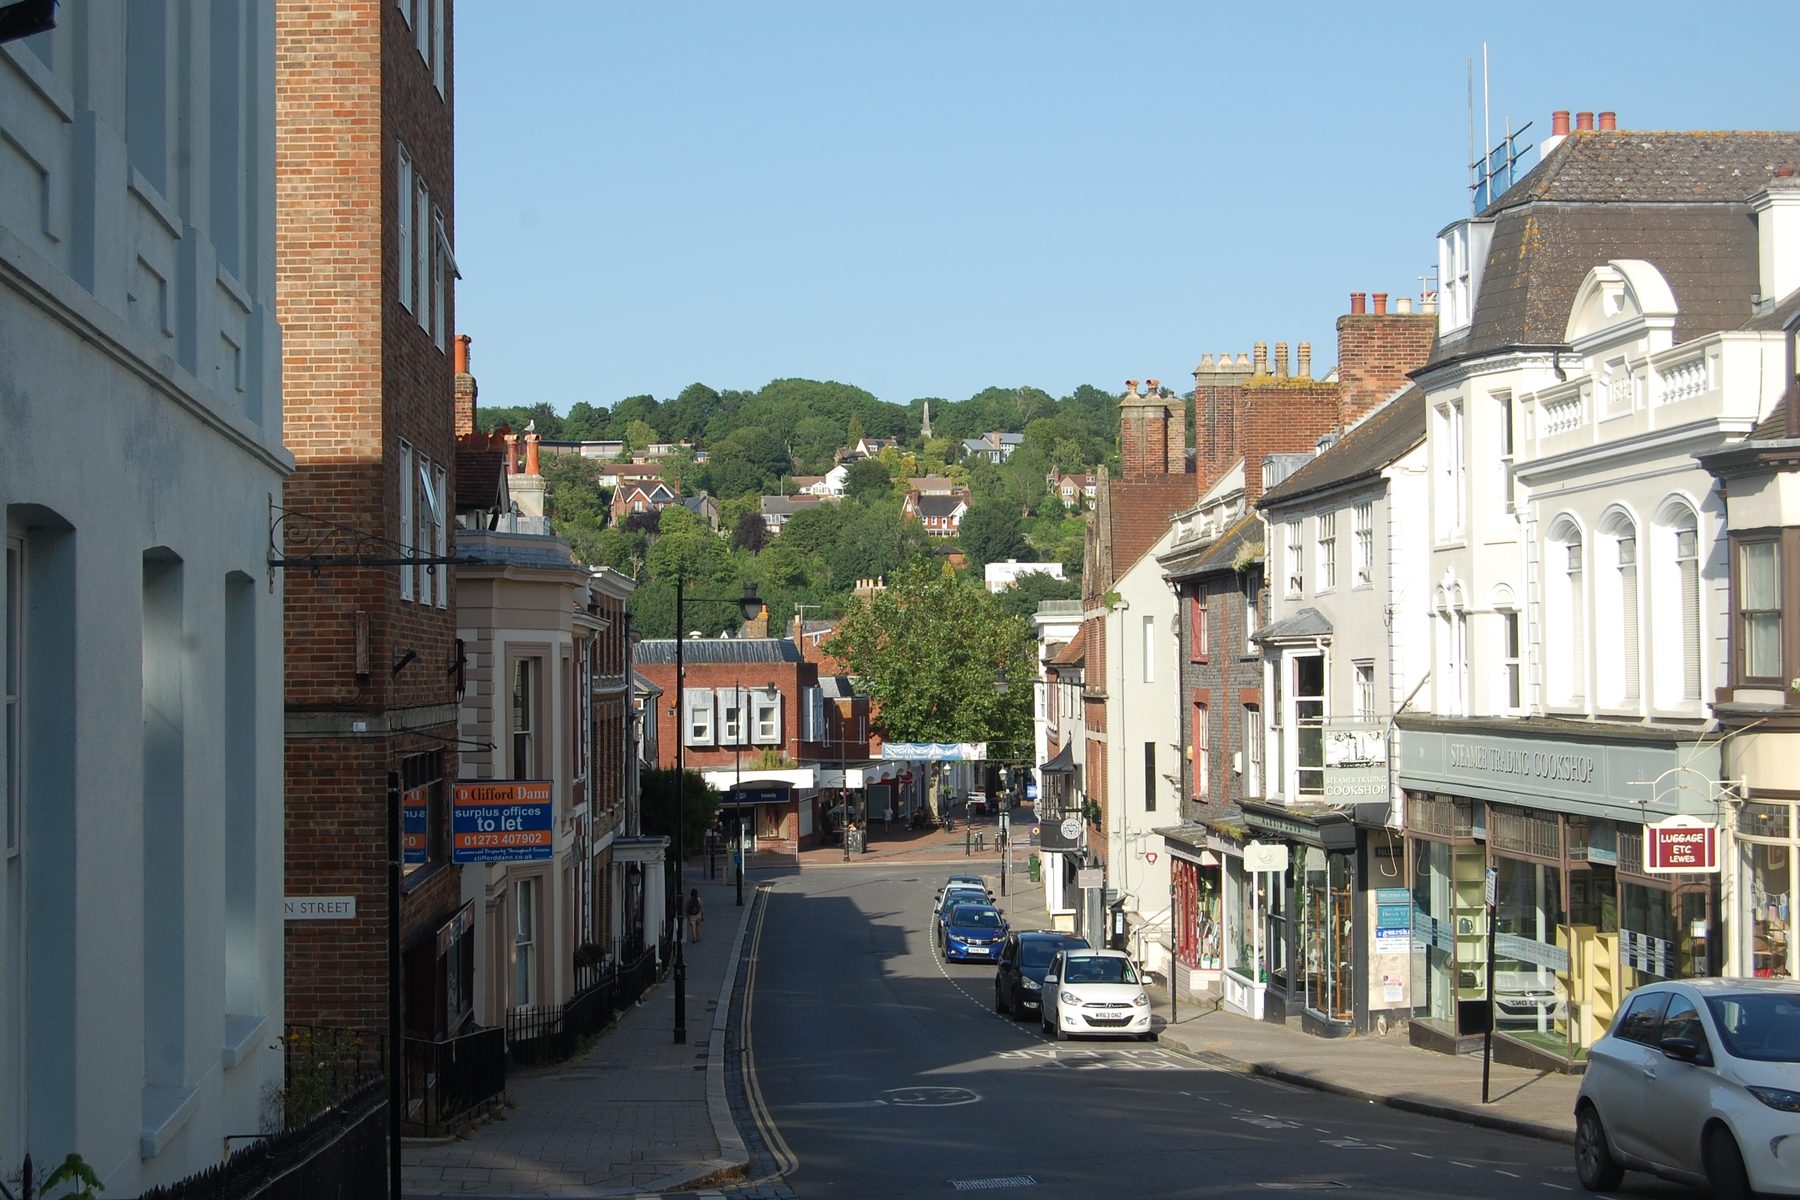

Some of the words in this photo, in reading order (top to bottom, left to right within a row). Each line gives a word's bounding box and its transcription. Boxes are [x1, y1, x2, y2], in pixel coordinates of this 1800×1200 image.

[1450, 744, 1488, 771] STEAMER
[1490, 749, 1529, 776] TRADING
[1533, 752, 1594, 783] COOKSHOP
[471, 787, 513, 801] Clifford
[517, 786, 549, 800] Dann
[1326, 785, 1387, 796] COOKSHOP
[455, 807, 499, 819] surplus
[503, 806, 541, 818] offices
[477, 816, 496, 832] to
[501, 815, 523, 831] let
[464, 834, 499, 846] 01273
[502, 833, 542, 845] 407902
[1660, 833, 1704, 843] LUGGAGE
[1673, 845, 1692, 854] ETC
[474, 854, 533, 862] clifforddann.co.uk
[1669, 855, 1696, 863] LEWES
[300, 902, 350, 913] STREET
